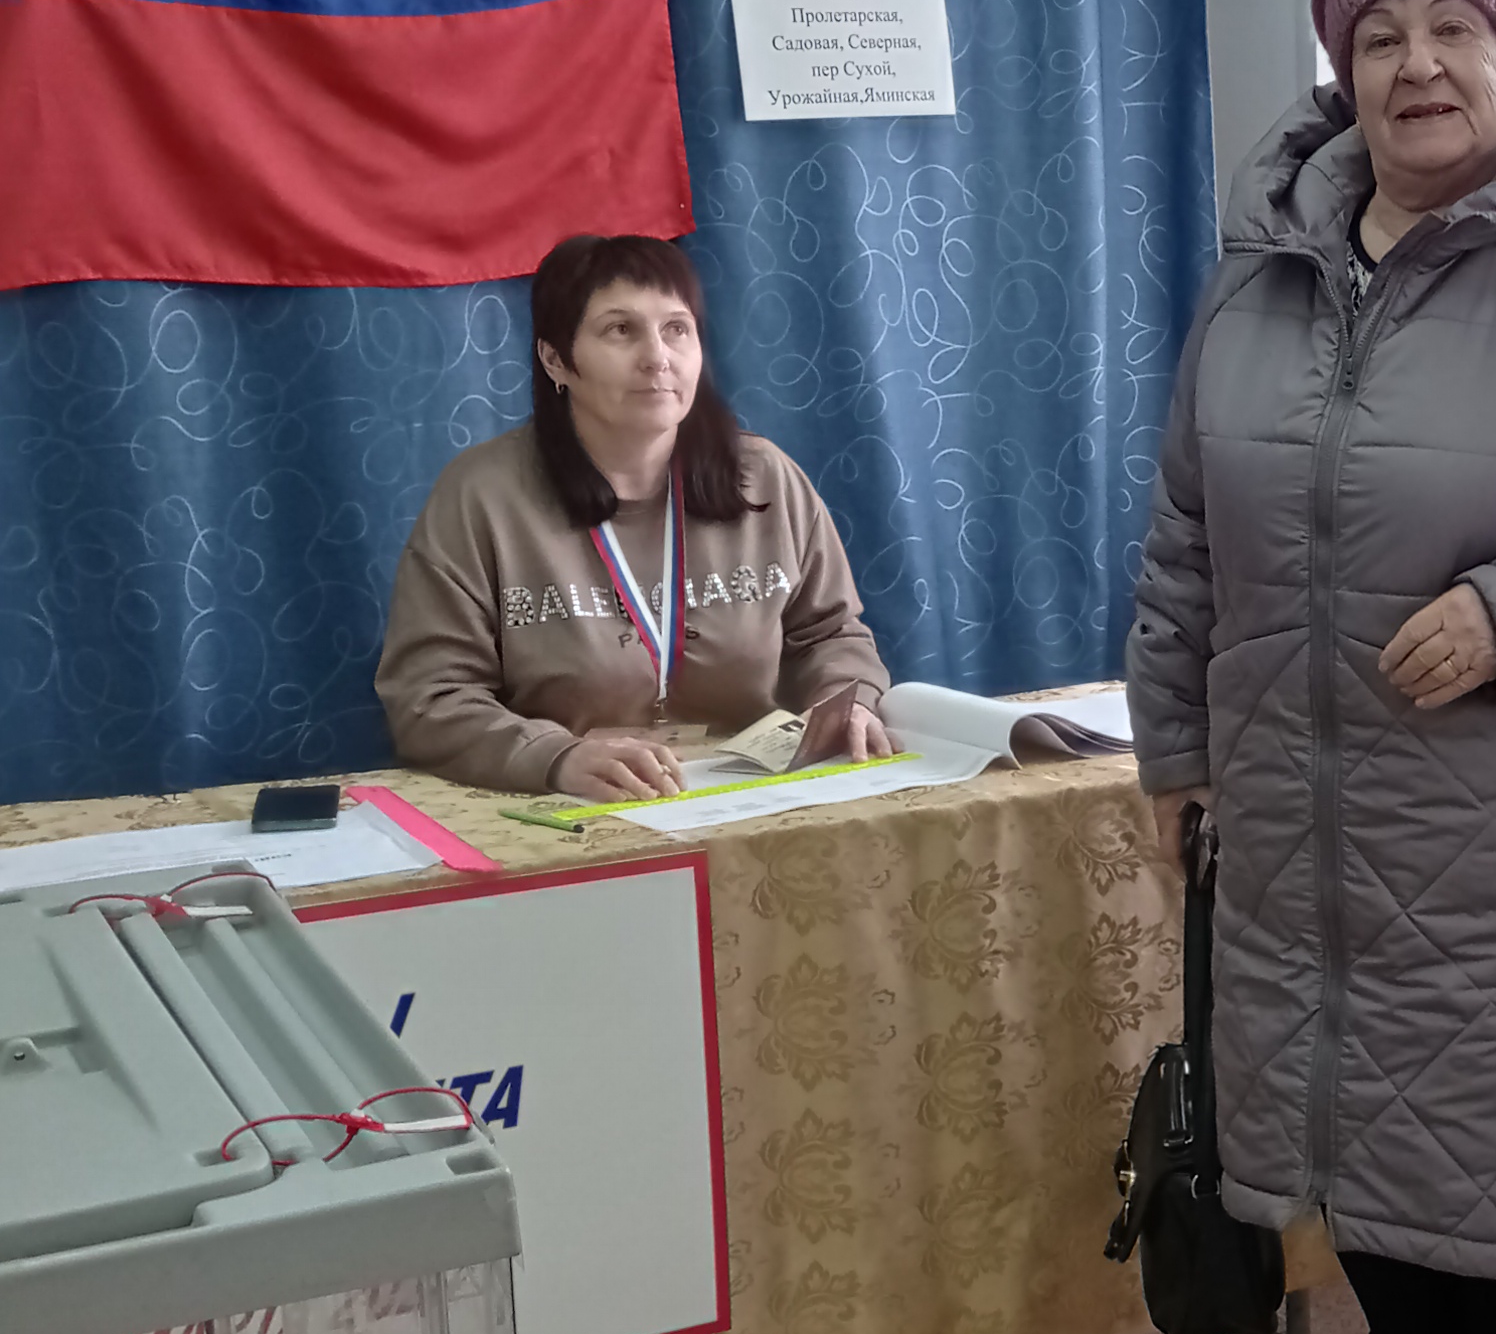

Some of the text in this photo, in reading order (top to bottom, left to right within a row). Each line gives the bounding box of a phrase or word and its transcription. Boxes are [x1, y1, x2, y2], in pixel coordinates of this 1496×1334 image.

[791, 7, 904, 27] Пролетарская,
[771, 33, 922, 52] Садовая, Северная,
[811, 61, 897, 80] пер Сухой,
